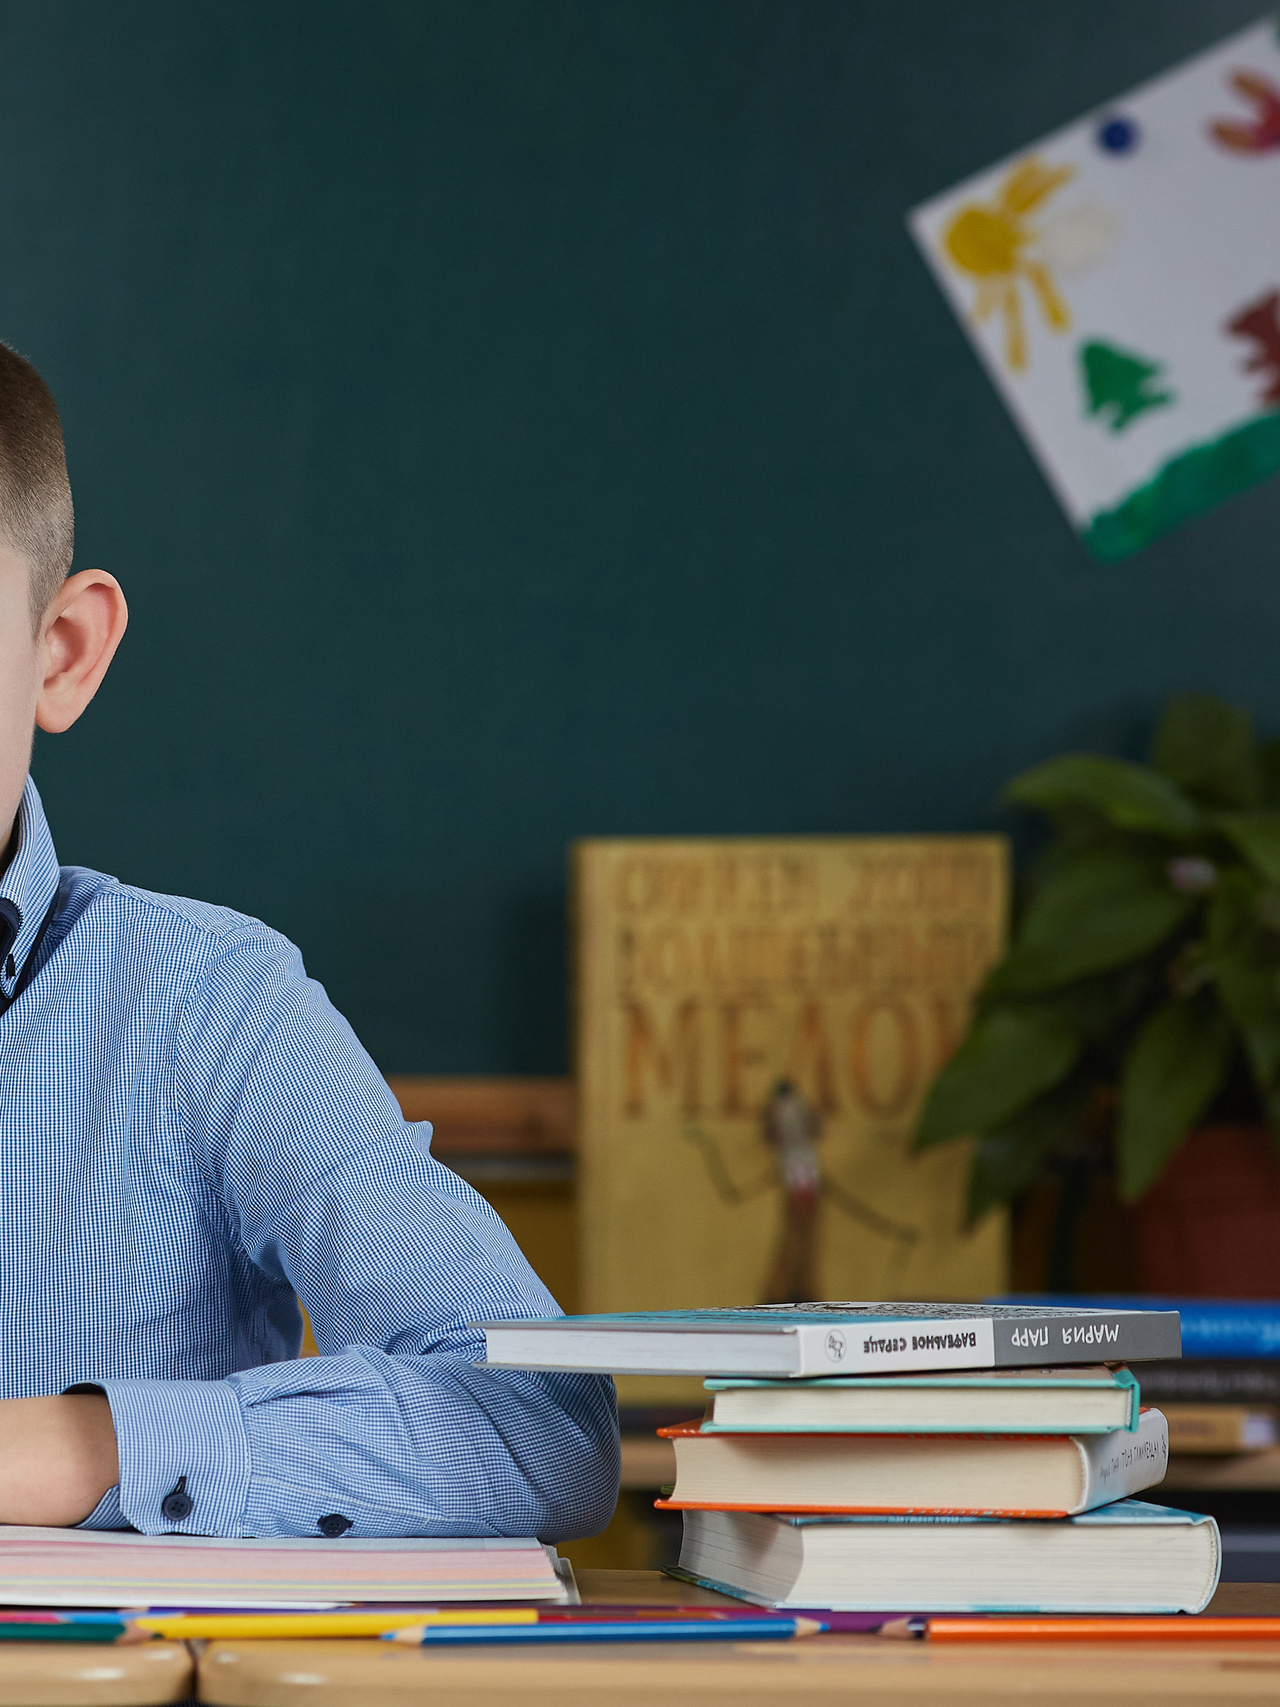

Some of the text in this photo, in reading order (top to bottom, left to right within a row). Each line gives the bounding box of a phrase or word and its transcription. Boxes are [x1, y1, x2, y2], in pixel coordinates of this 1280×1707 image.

[863, 1331, 977, 1354] ВАФЕЛЬНОЕ СЕРДЦЕ
[1011, 1323, 1120, 1347] МАРИЯ ПАРР
